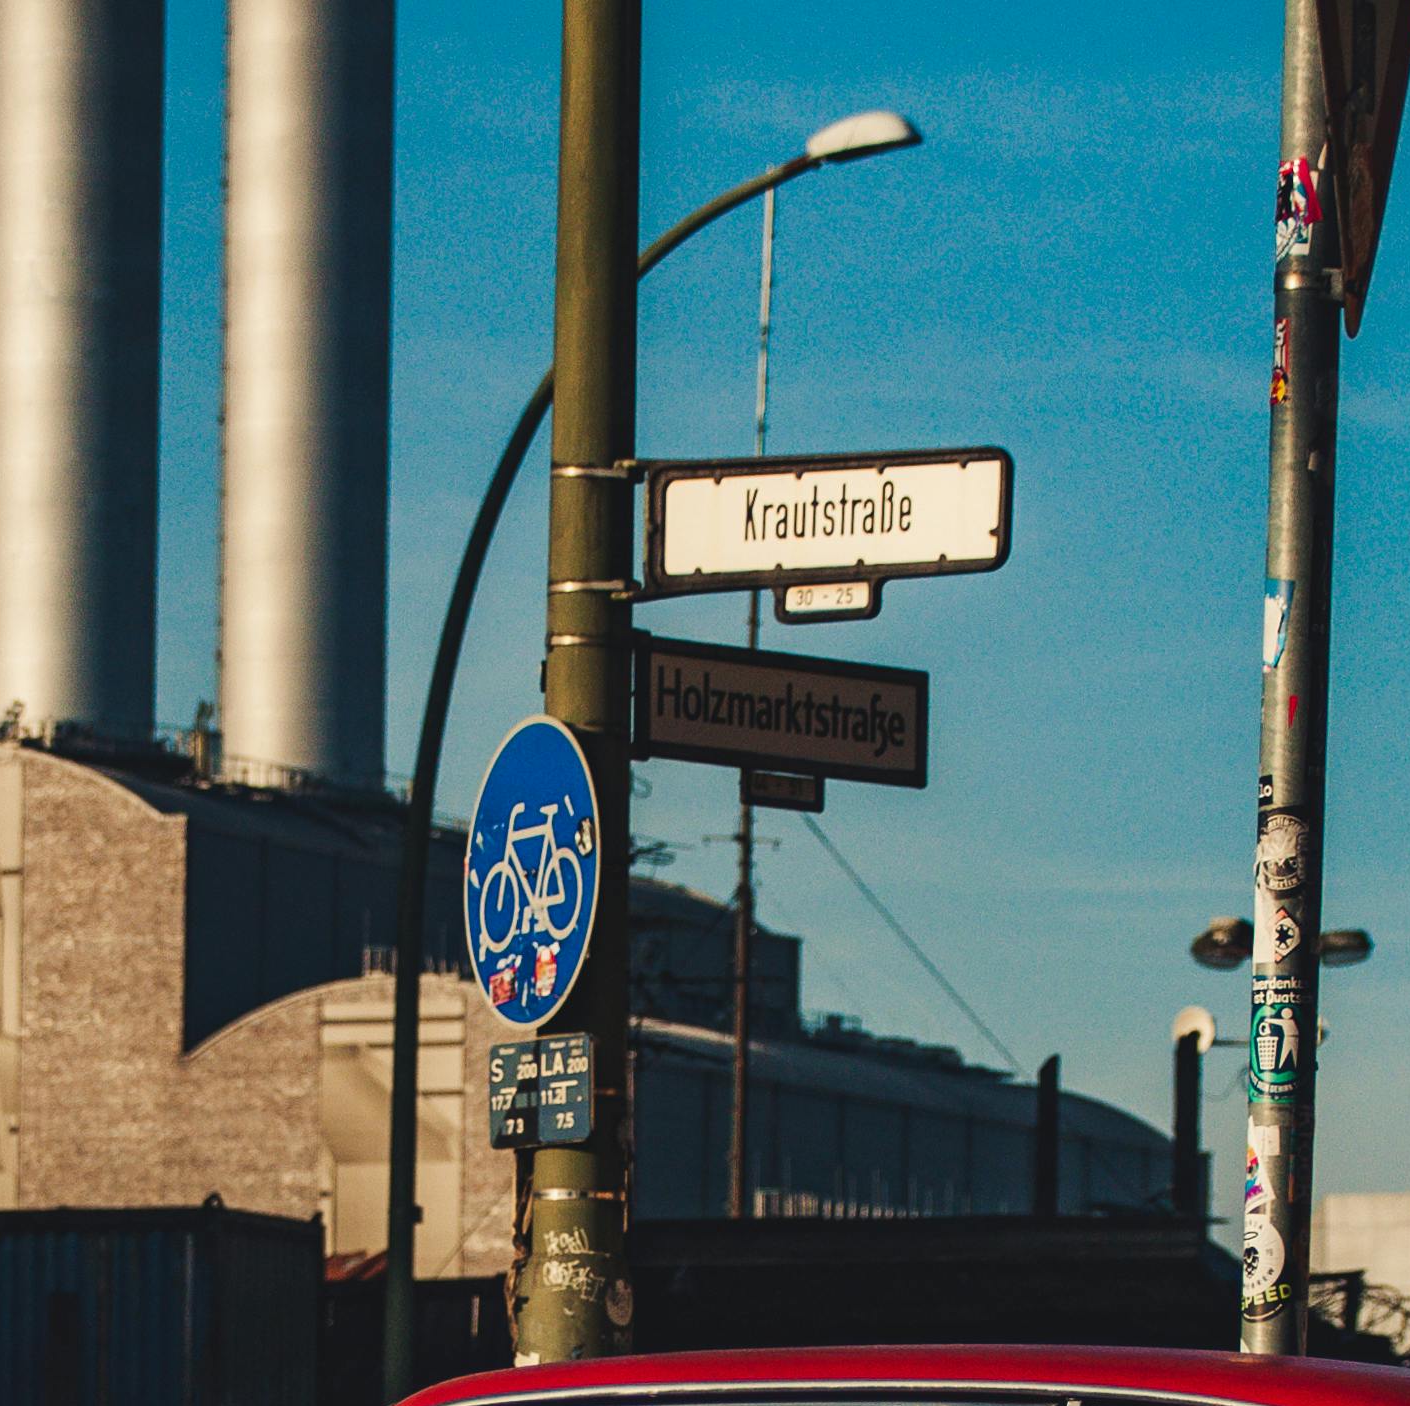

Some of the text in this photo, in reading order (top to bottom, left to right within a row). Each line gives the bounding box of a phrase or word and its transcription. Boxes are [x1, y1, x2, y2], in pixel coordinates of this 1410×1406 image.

[742, 480, 914, 543] Krautstraße
[796, 587, 814, 606] 30
[835, 586, 855, 605] 25
[656, 664, 907, 758] Holzmarktstraße
[490, 1057, 538, 1084] S 200
[540, 1050, 589, 1078] LA 200
